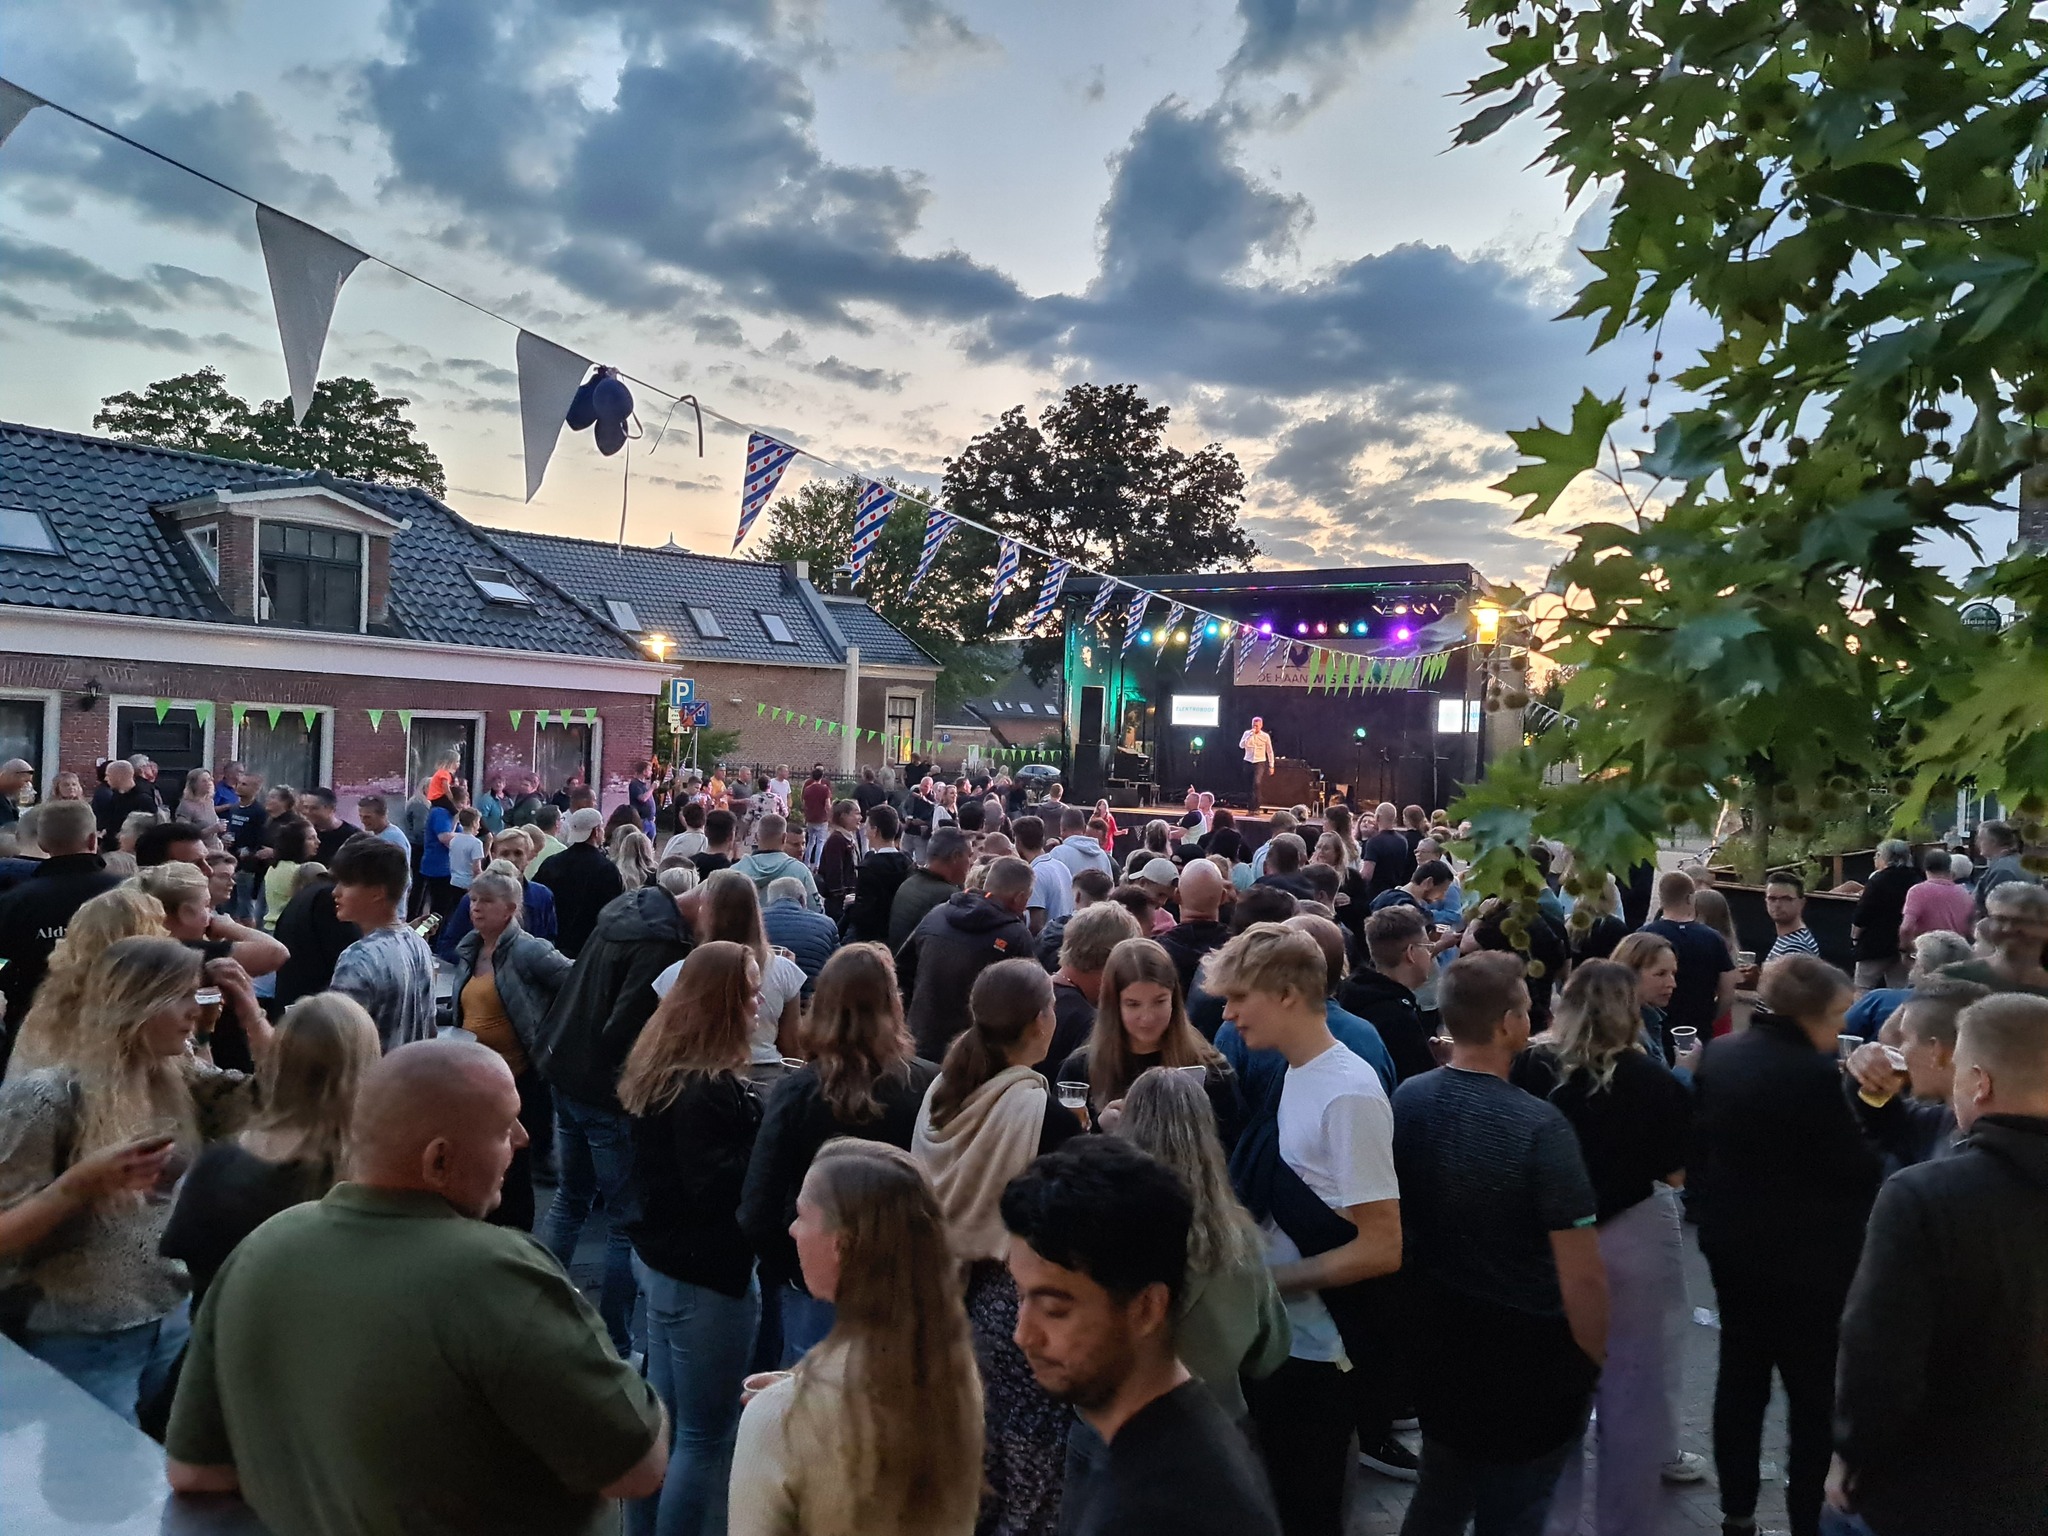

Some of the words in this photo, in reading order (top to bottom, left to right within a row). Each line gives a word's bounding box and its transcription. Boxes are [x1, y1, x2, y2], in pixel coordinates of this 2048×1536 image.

[1258, 673, 1271, 682] DE
[1275, 674, 1308, 683] HAAN
[677, 681, 690, 705] P
[943, 734, 949, 742] P
[36, 926, 68, 939] Ald
